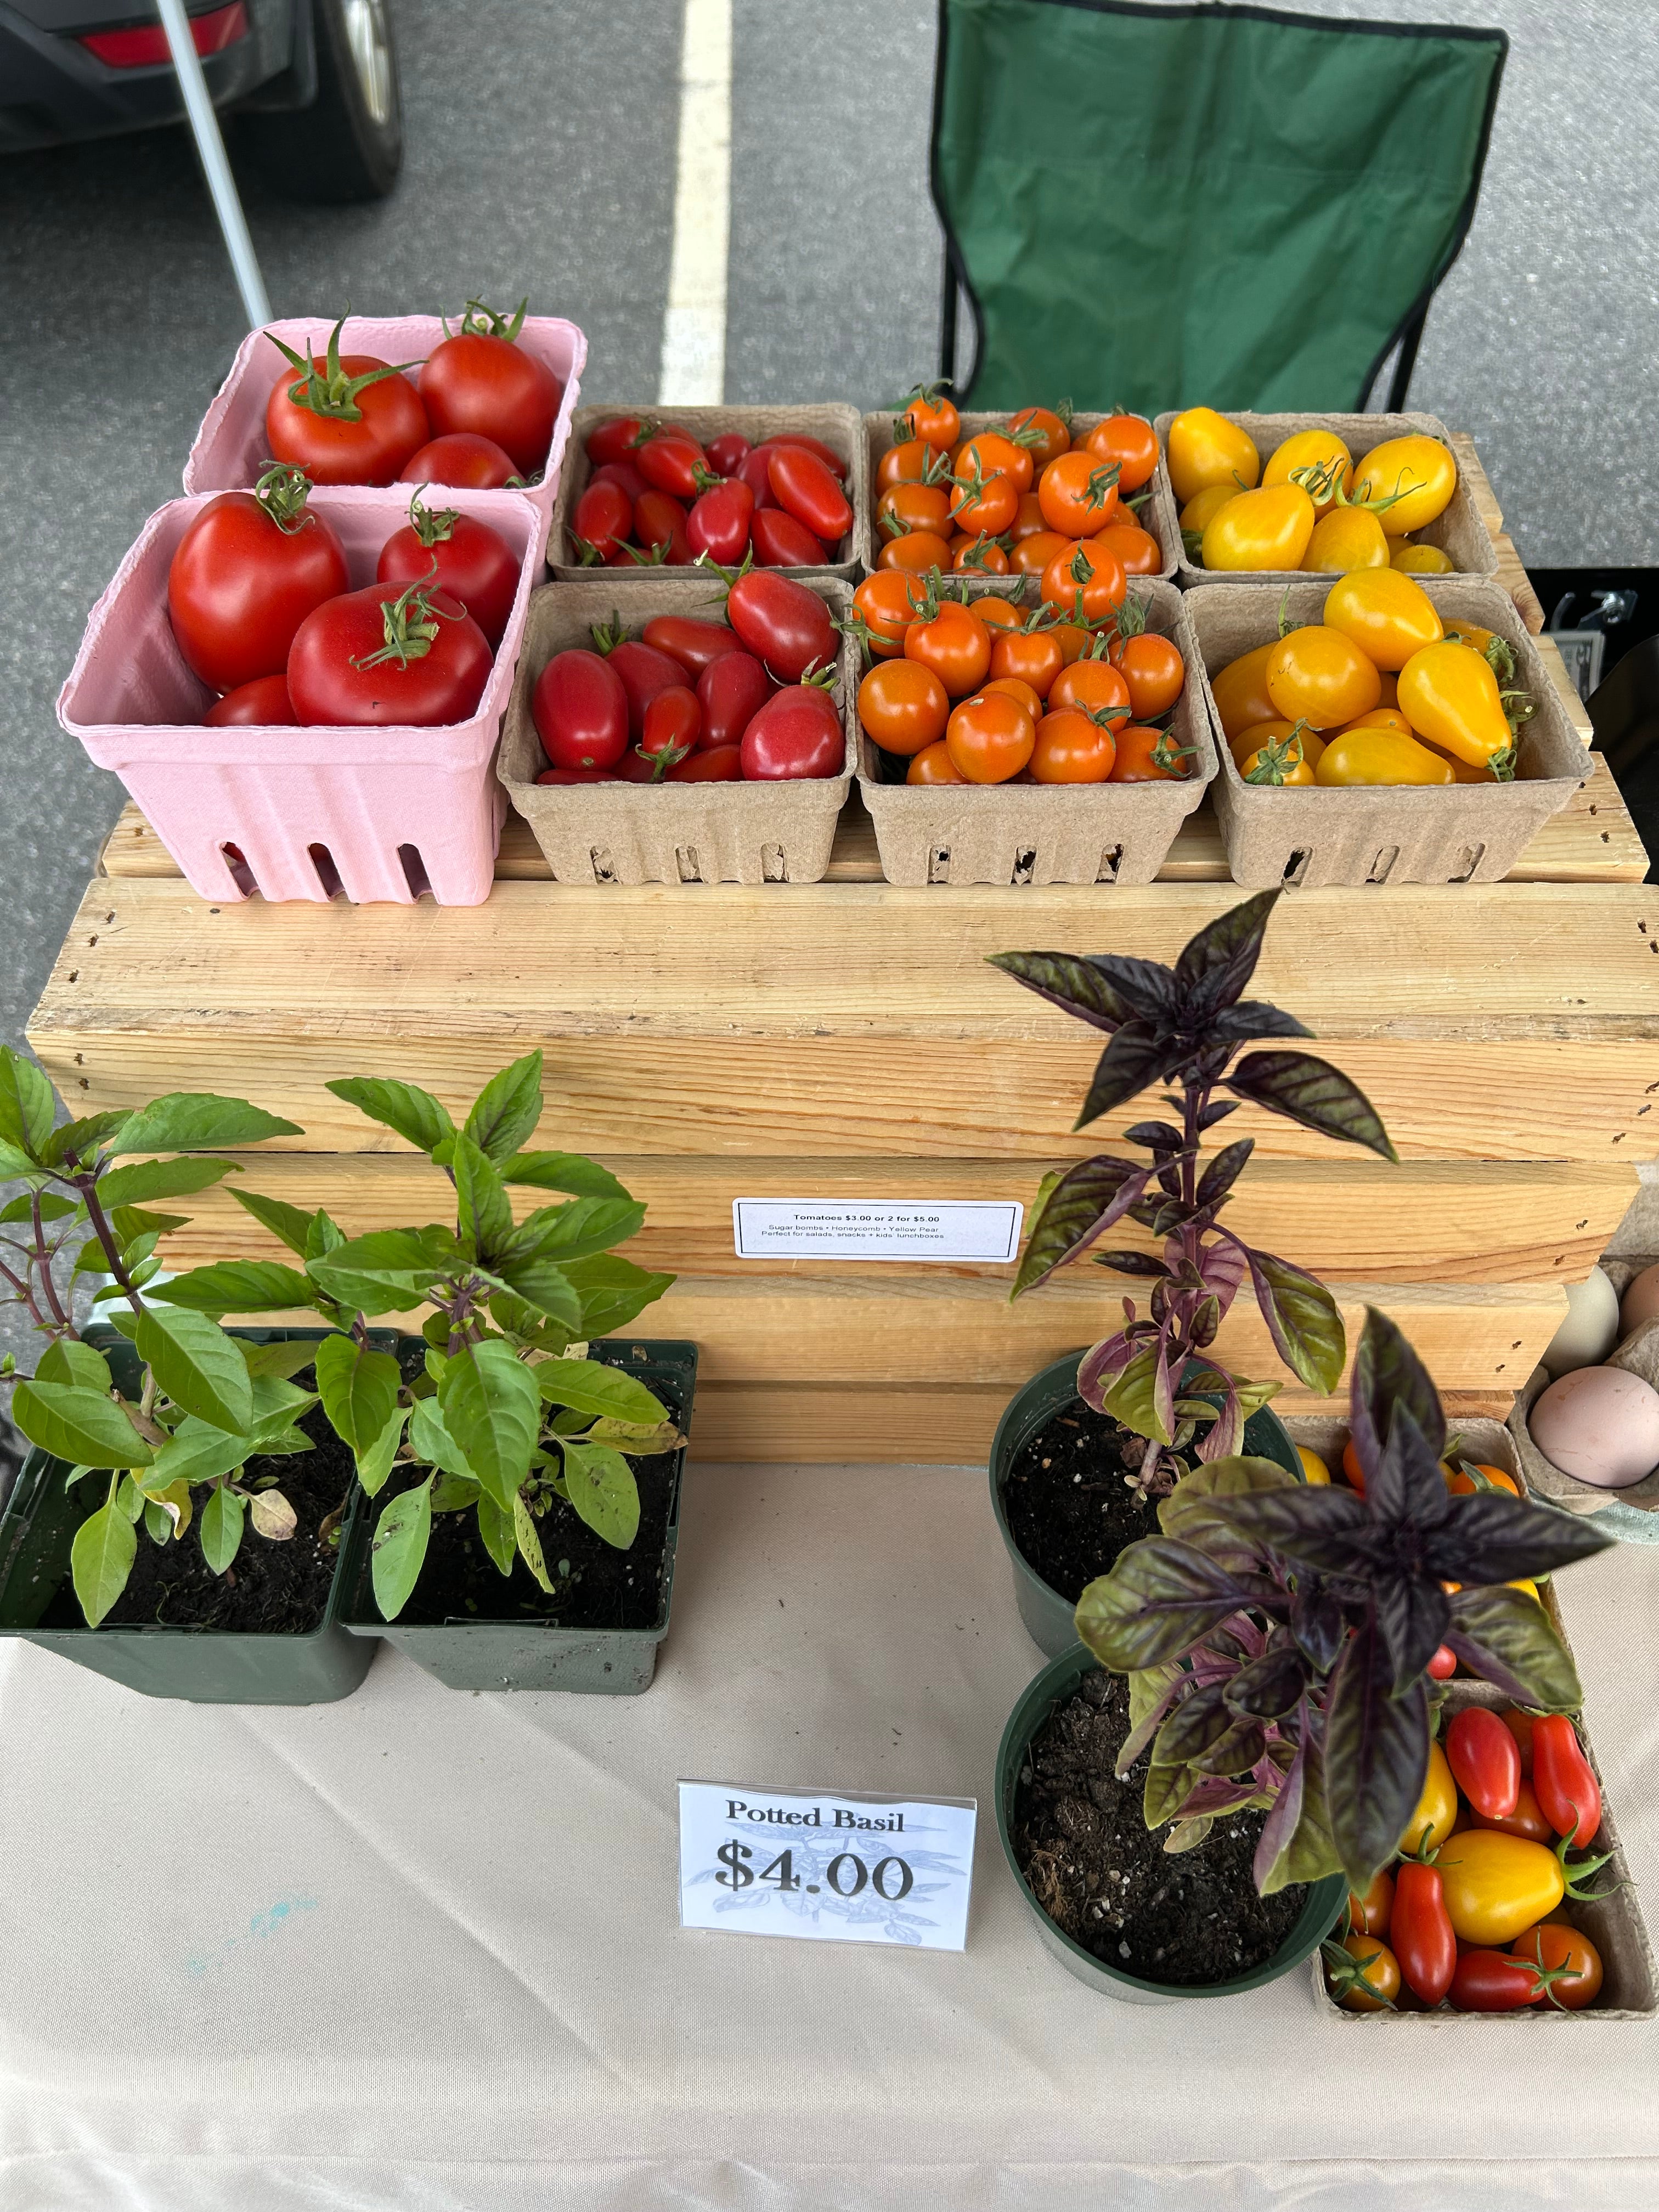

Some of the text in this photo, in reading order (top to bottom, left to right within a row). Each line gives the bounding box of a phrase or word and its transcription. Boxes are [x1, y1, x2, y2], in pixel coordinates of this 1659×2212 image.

[725, 1799, 905, 1831] Potted Basil
[715, 1839, 913, 1900] $4.00
